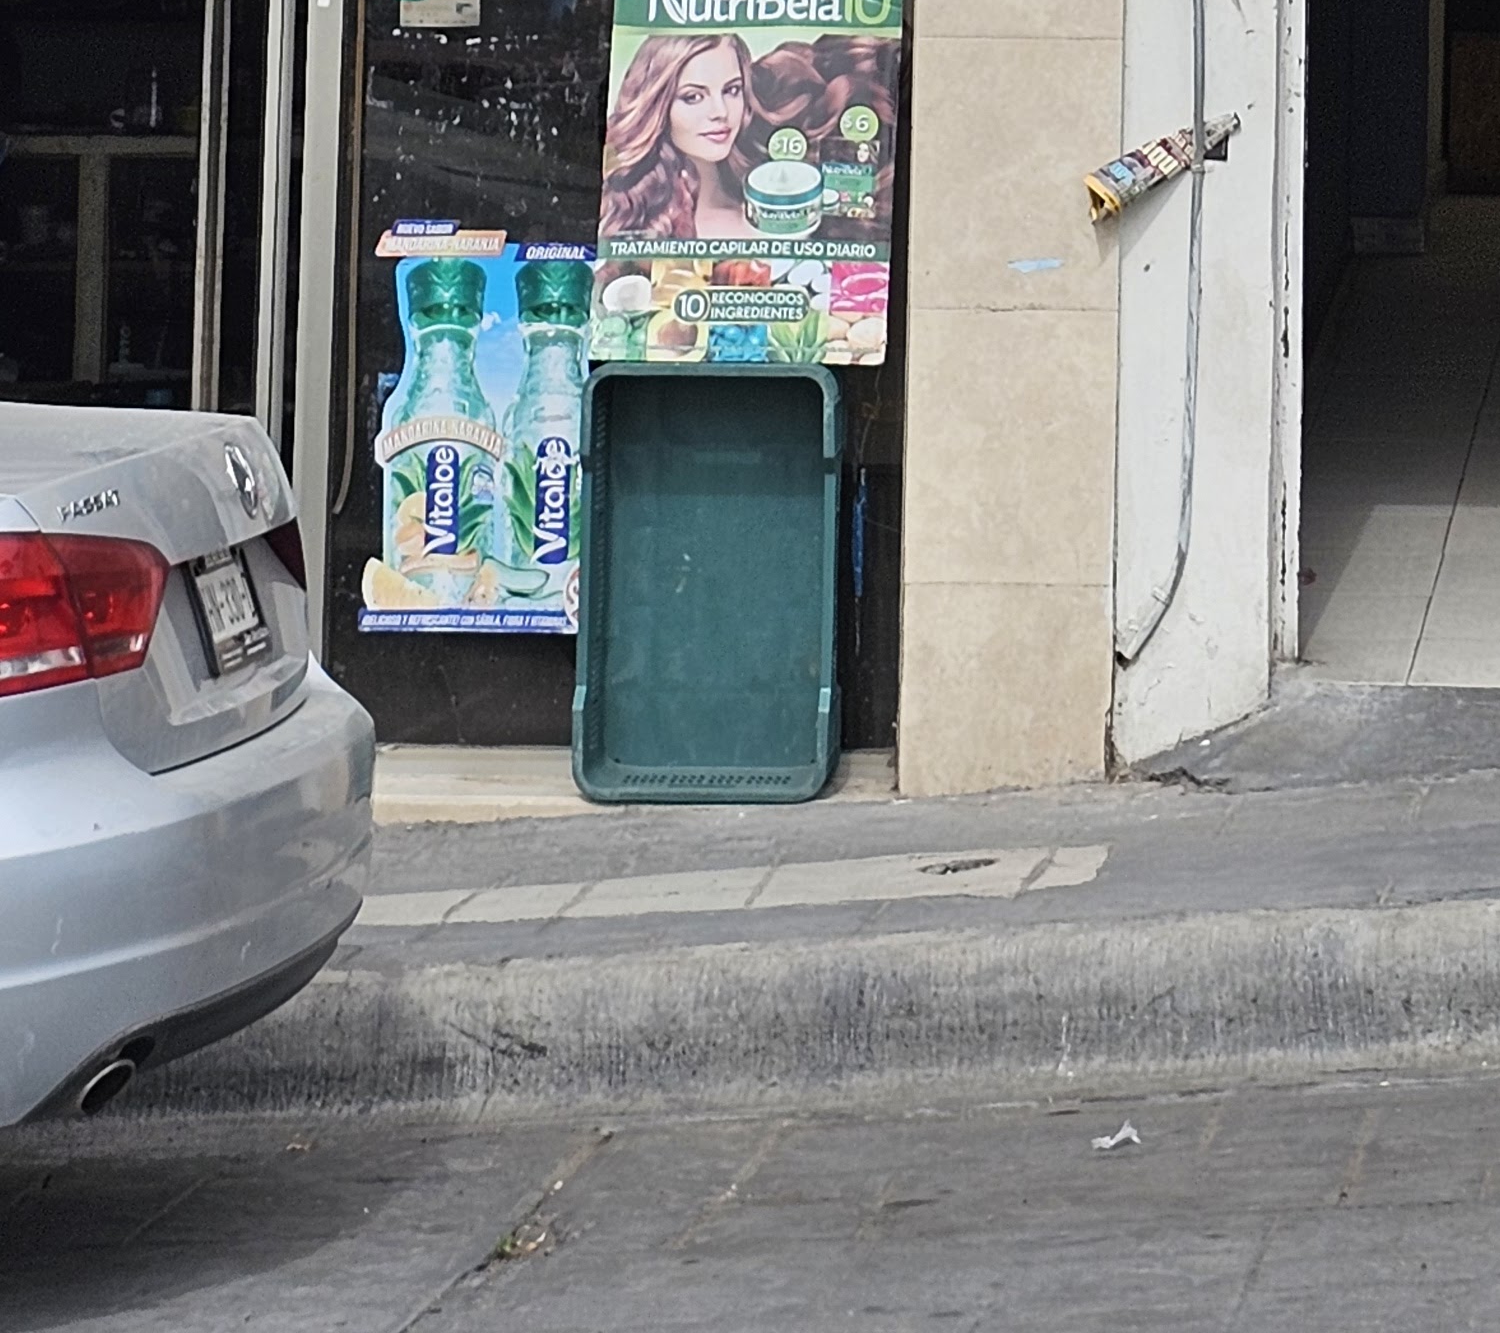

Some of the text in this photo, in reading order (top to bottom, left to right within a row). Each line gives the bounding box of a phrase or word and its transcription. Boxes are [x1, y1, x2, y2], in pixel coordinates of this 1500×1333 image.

[526, 245, 587, 260] ORIGINAL
[610, 240, 876, 258] TRATAMIENTO CAPILAR DE USO DIARIO
[678, 291, 706, 317] 10
[711, 291, 804, 306] RECONOCIDOS
[710, 306, 804, 320] INGREDIENTES
[422, 445, 457, 557] Vitaloe
[530, 437, 568, 564] Vitaloe
